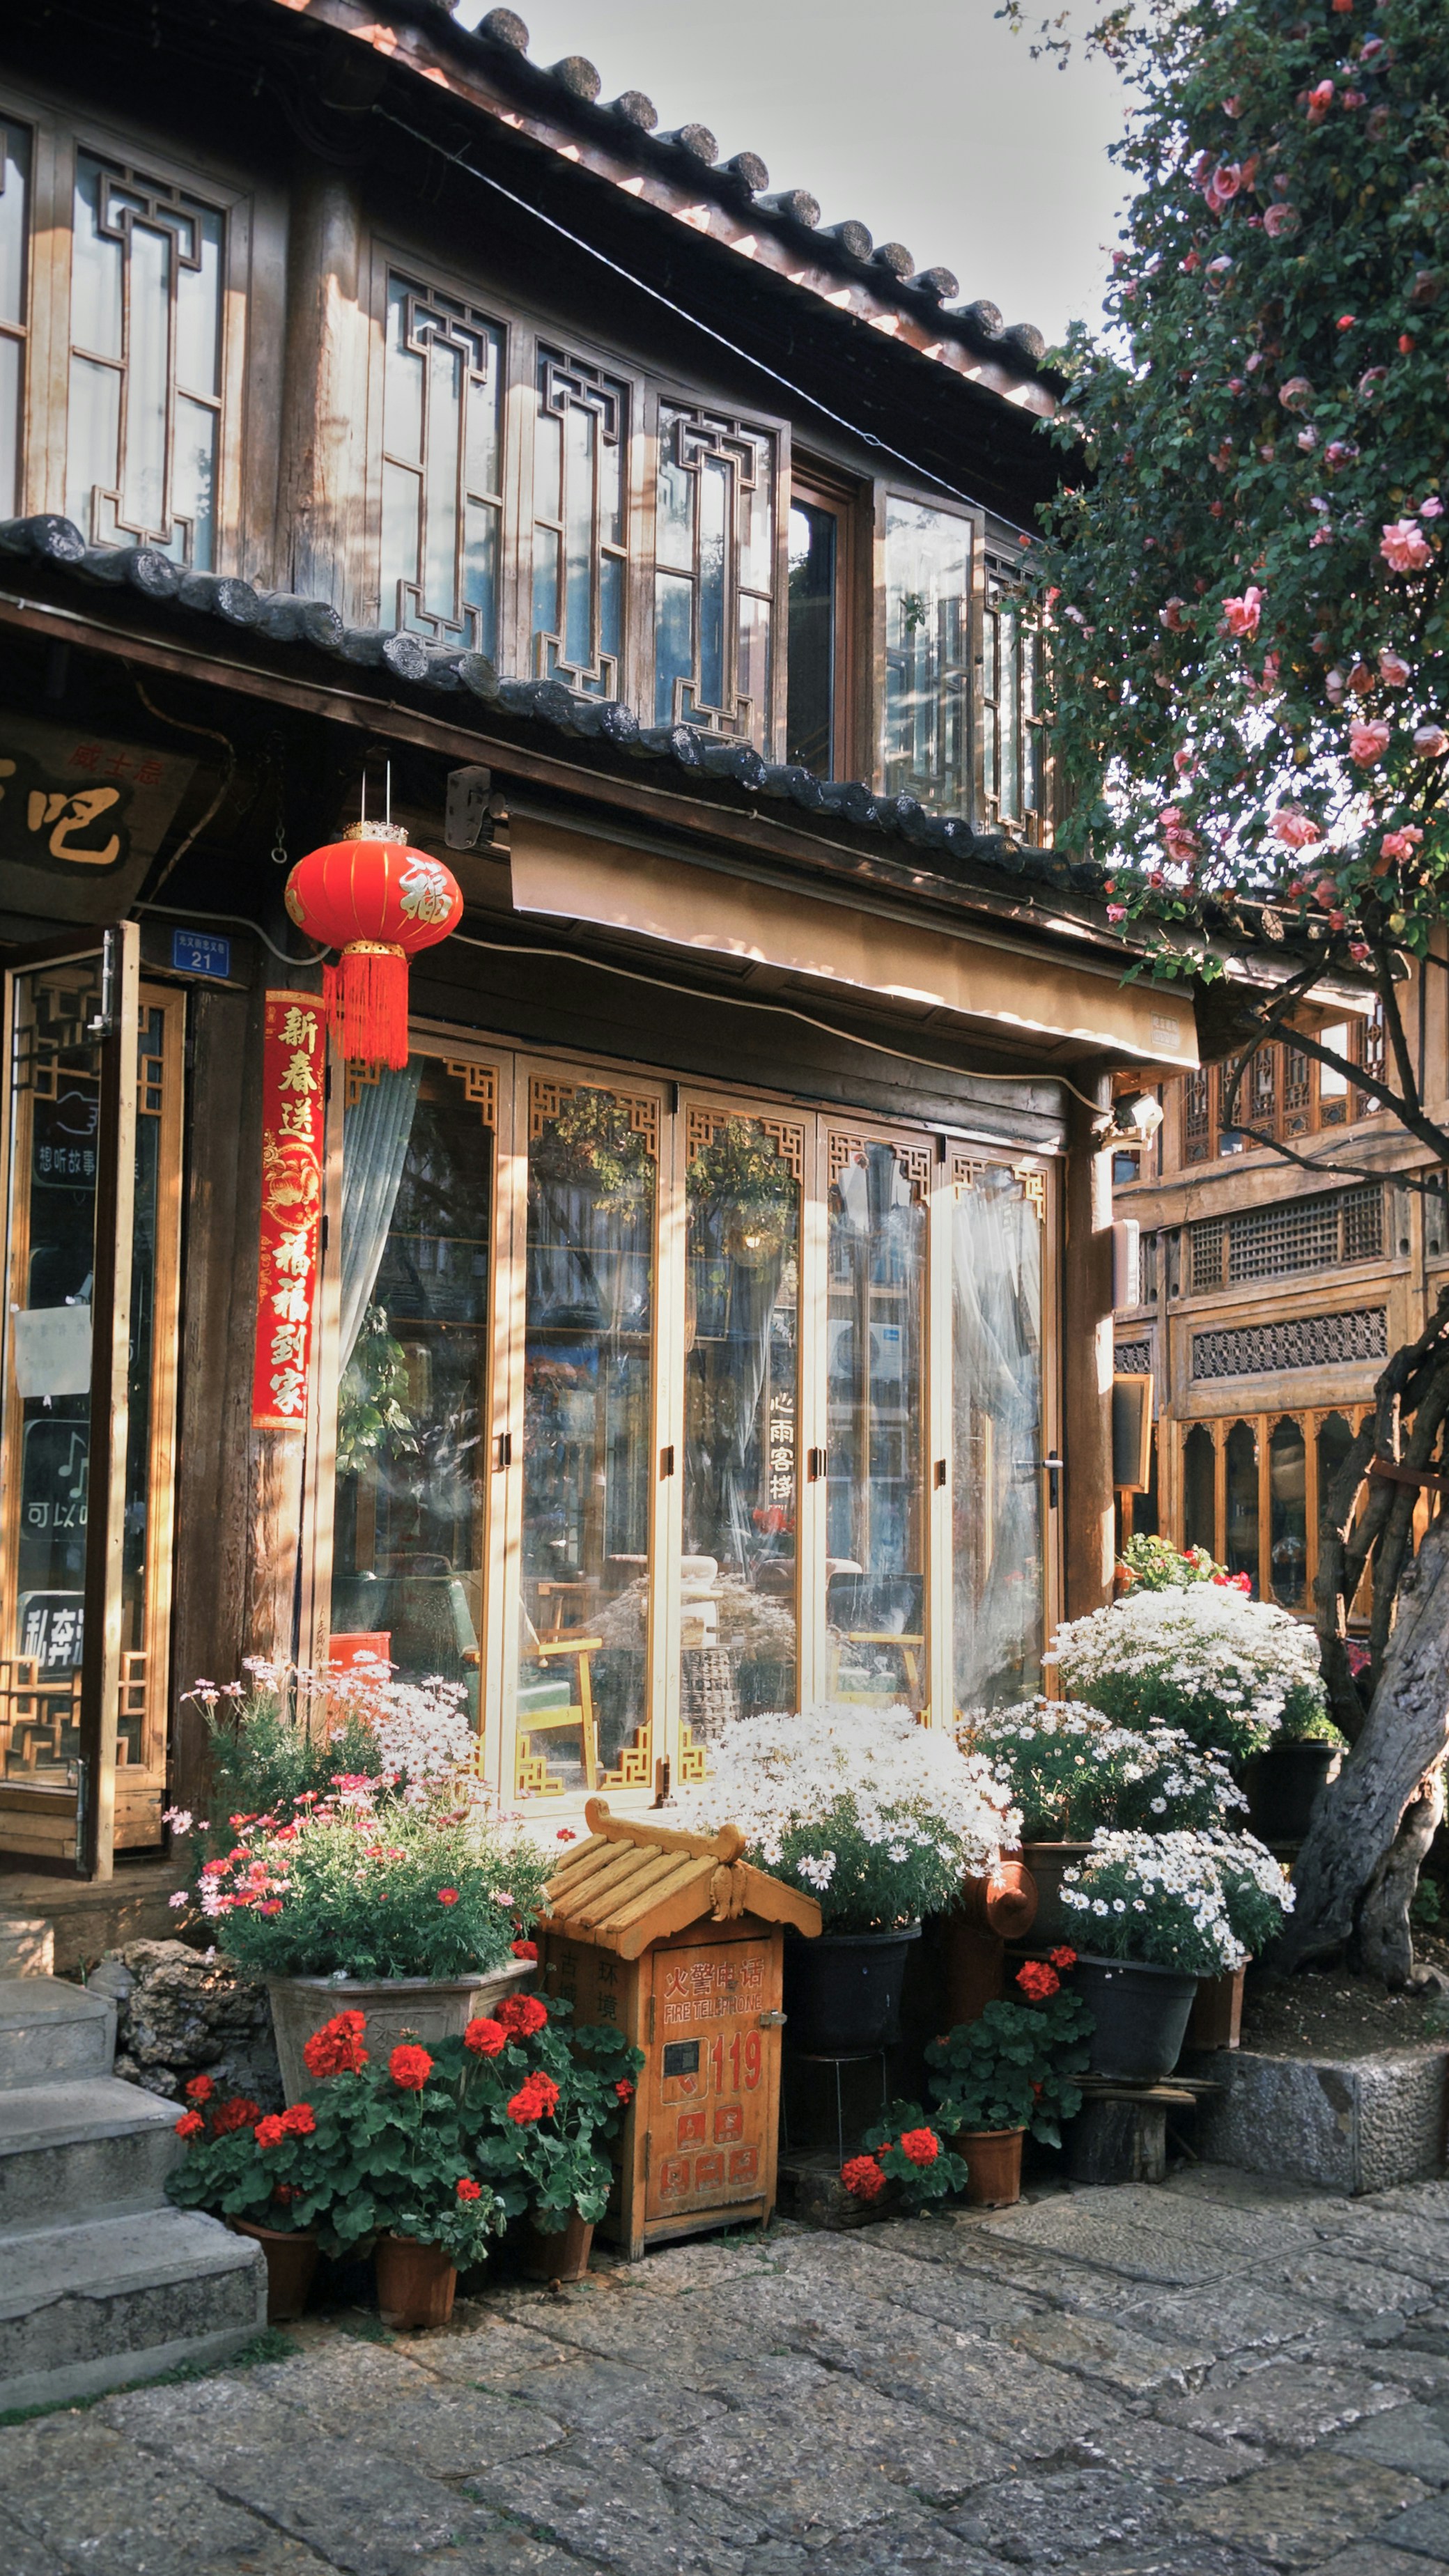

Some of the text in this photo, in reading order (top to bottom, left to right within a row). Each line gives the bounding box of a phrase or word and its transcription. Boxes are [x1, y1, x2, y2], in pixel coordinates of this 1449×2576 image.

[68, 743, 164, 786] 威士忌
[0, 758, 121, 865] 吧
[398, 856, 454, 925] 福
[191, 951, 210, 970] 21
[39, 1146, 95, 1176] 想听故事
[270, 1007, 318, 1415] 新春送福福到家
[664, 1957, 764, 1999] 火警电话
[664, 1993, 763, 2024] FIRE TELEPHONE
[711, 2029, 762, 2097] 119
